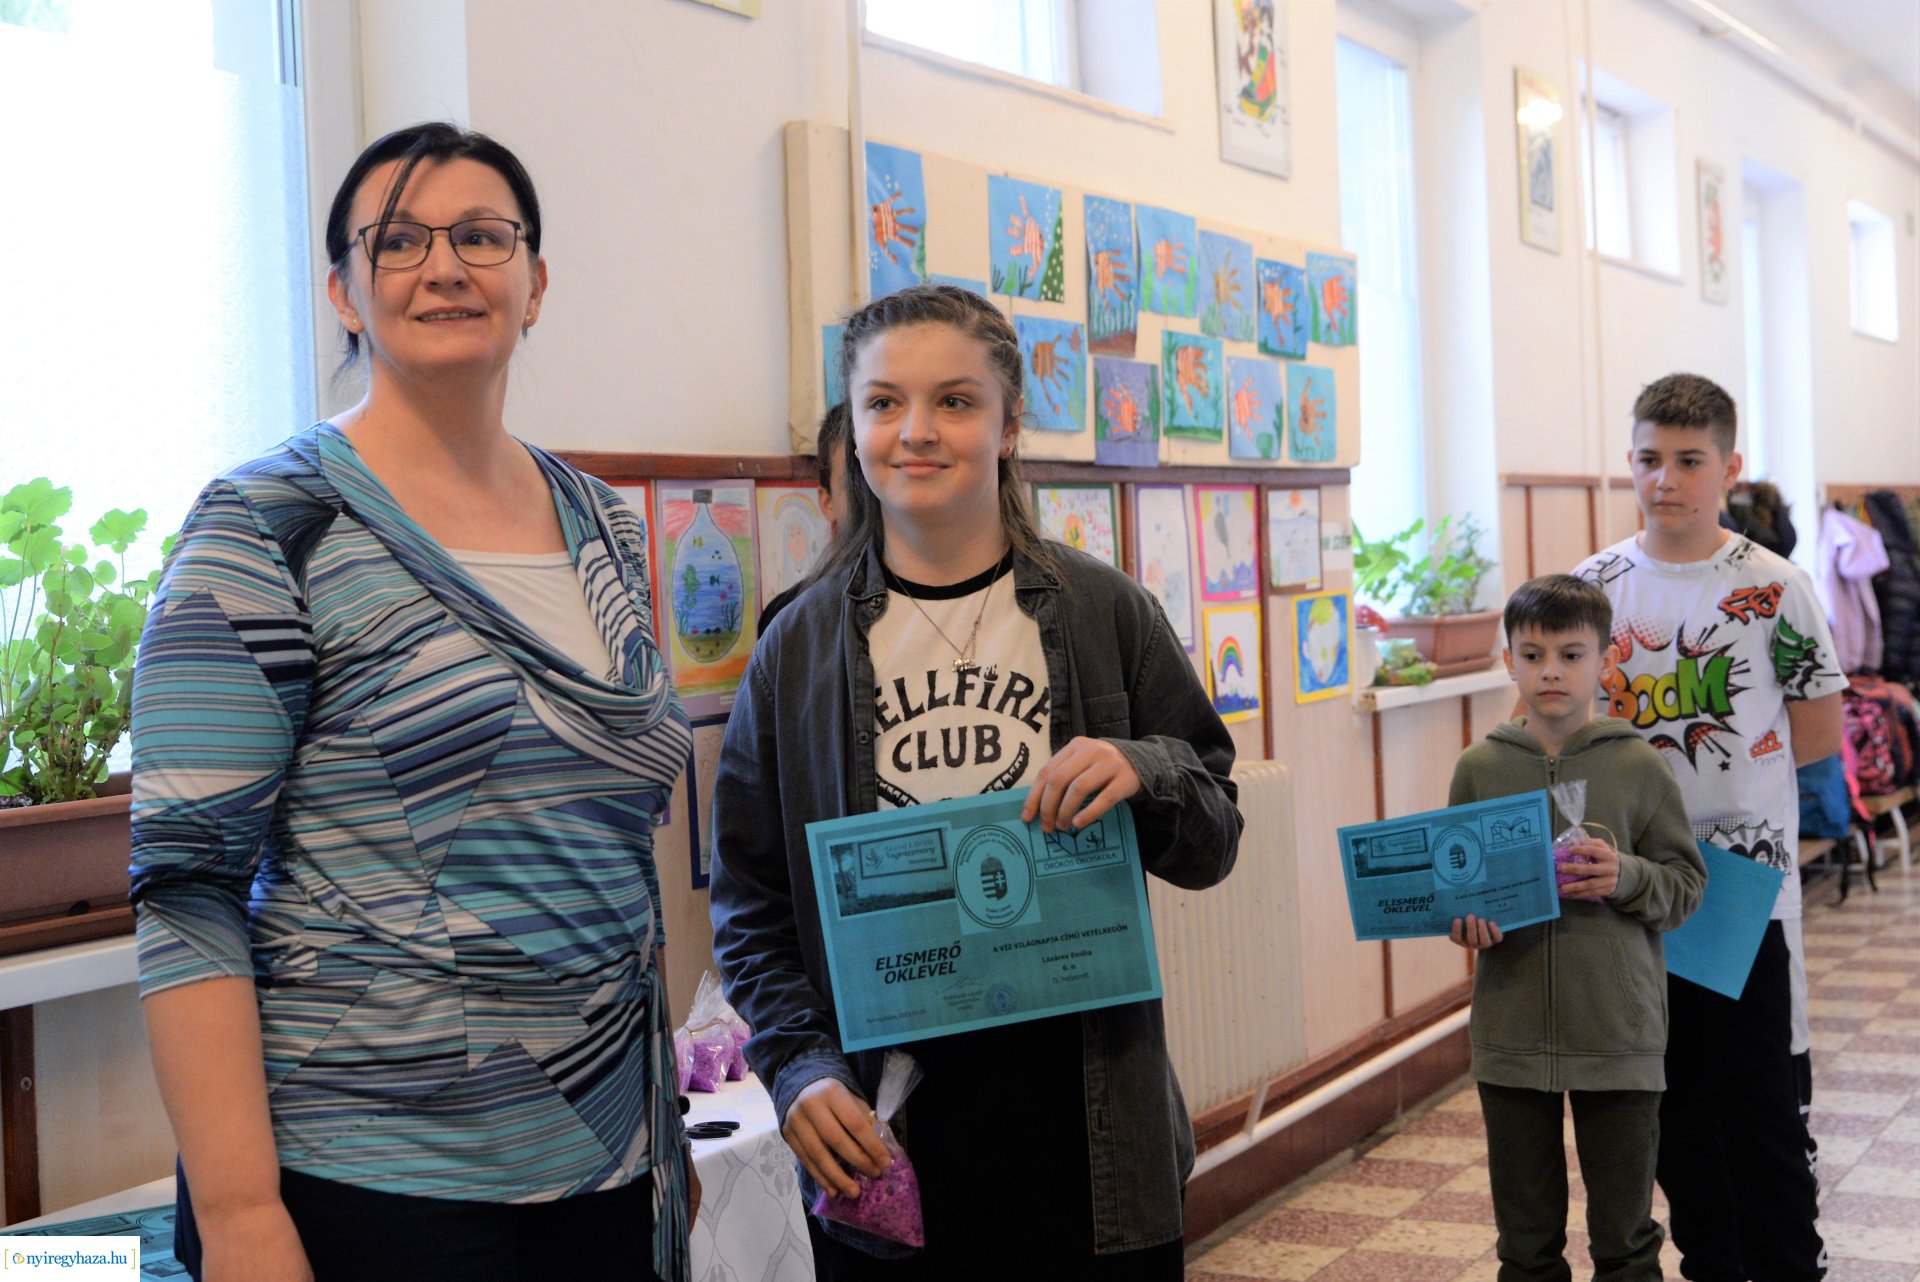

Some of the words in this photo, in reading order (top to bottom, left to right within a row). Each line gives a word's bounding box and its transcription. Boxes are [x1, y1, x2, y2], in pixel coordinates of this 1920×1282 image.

[875, 665, 1050, 736] ELLFIRE
[1600, 655, 1735, 729] BOOM
[892, 724, 1002, 773] CLUB
